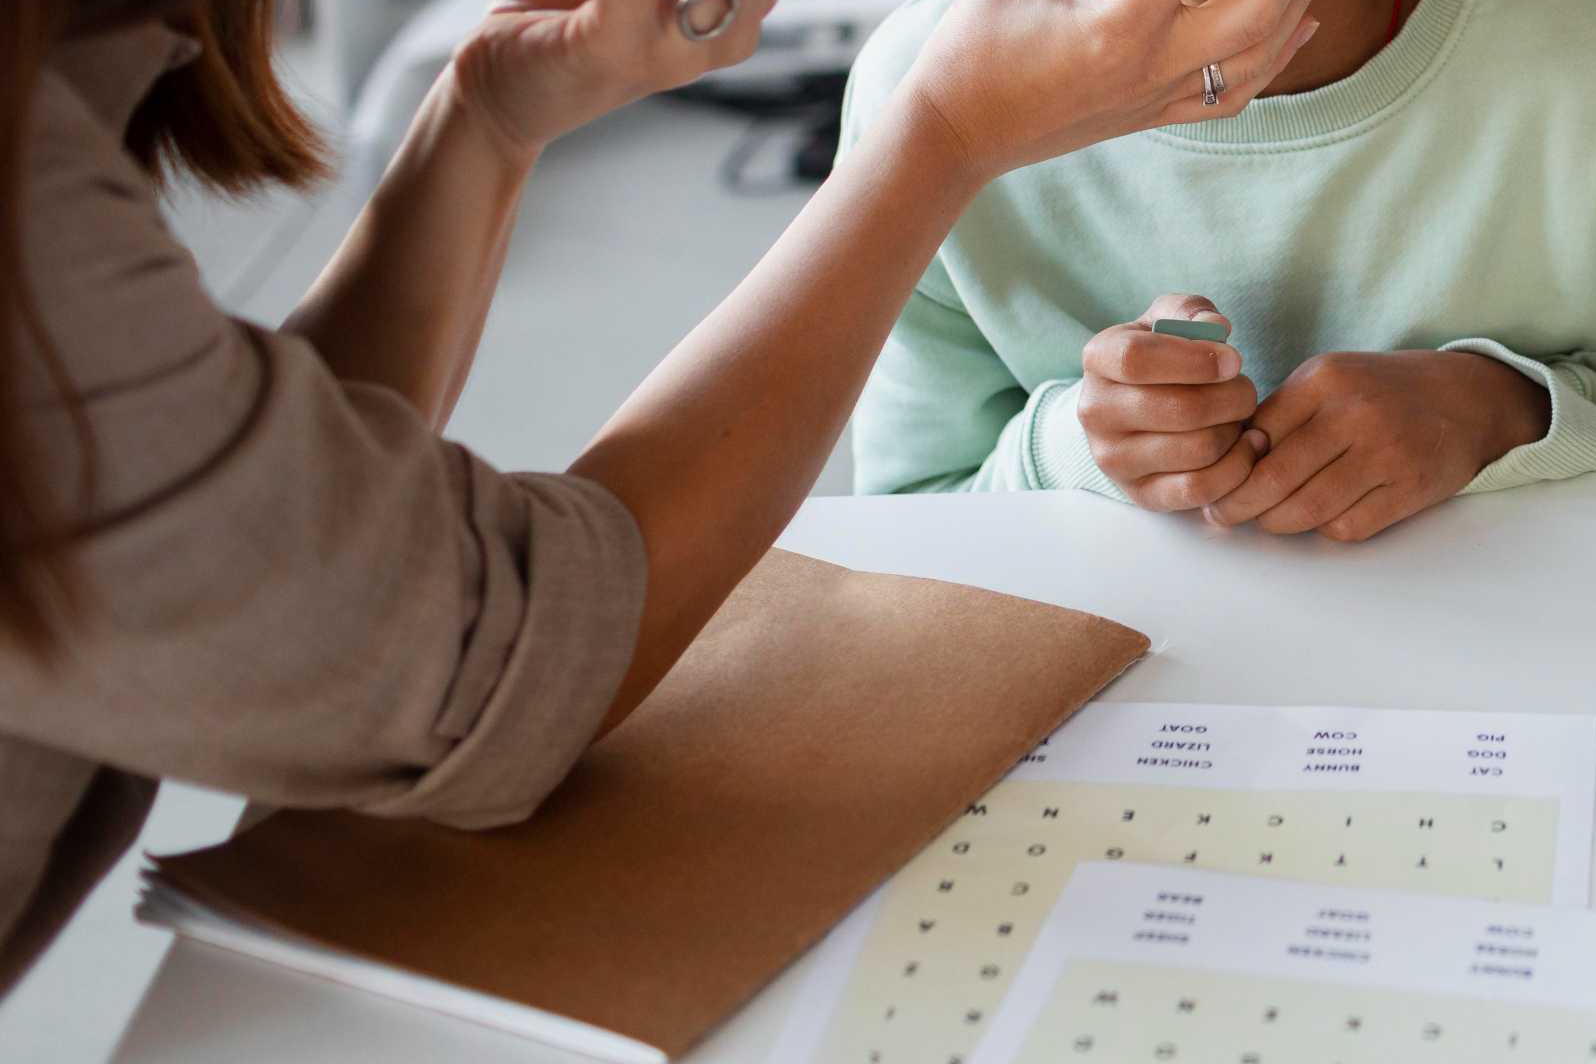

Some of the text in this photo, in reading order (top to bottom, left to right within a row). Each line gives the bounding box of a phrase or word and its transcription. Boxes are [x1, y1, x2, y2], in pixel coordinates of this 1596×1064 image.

[1158, 723, 1208, 735] GOAT
[1313, 730, 1358, 741] COW
[1476, 733, 1506, 743] PIG
[1150, 739, 1211, 752] LIZARD
[1306, 747, 1364, 757] HORSE
[1466, 749, 1508, 760] DOG
[1136, 756, 1214, 770] CHICKEN
[1302, 763, 1361, 773] BUNNY
[1469, 766, 1504, 777] CAT
[964, 803, 1508, 833] C H I C K E N W
[951, 841, 1506, 872] L T T K F G O D
[1012, 881, 1030, 896] C
